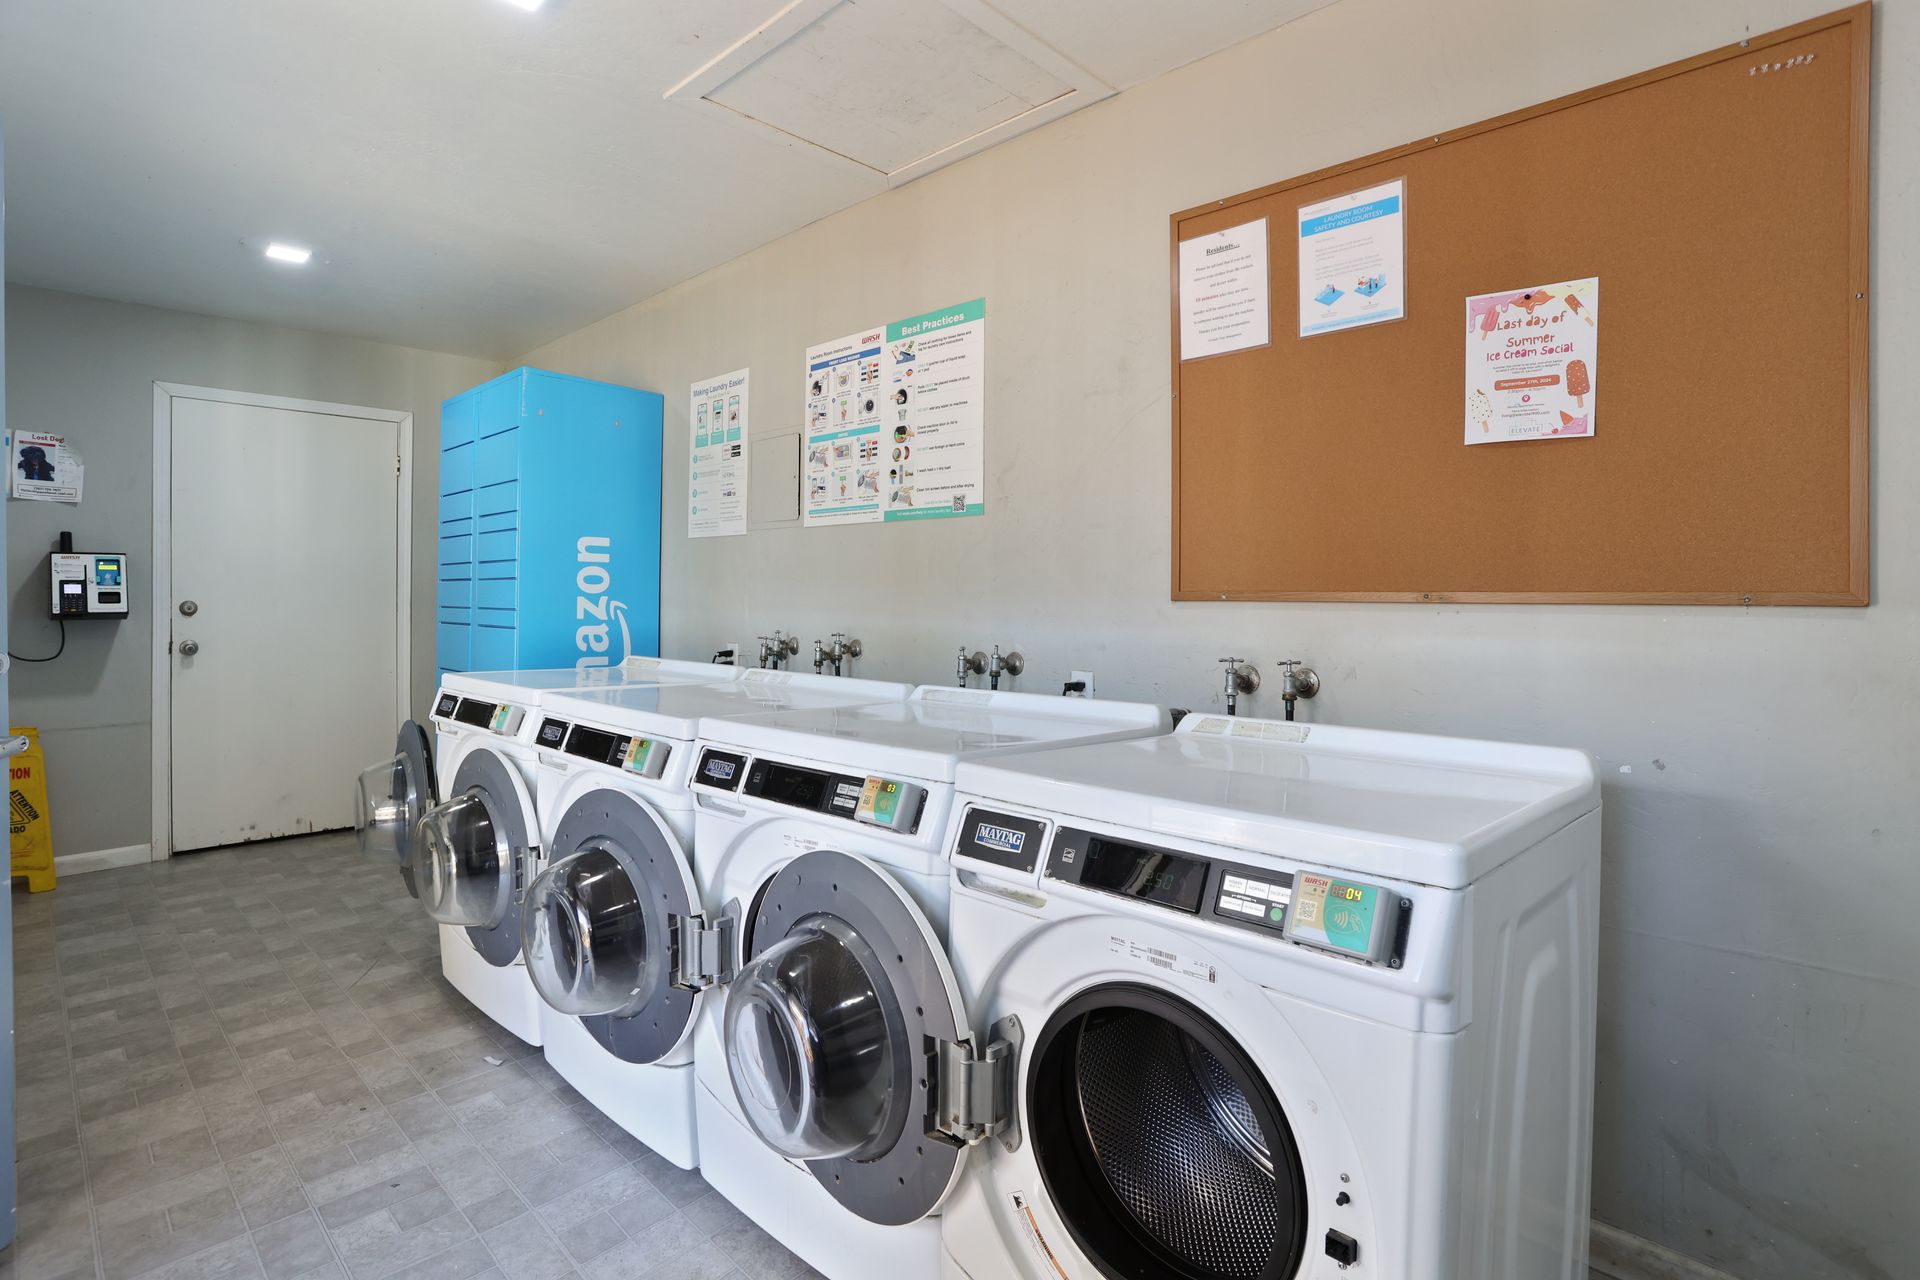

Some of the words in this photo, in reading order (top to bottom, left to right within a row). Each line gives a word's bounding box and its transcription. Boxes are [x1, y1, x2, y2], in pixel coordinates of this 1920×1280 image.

[1313, 221, 1335, 233] SAFETY
[1336, 218, 1351, 229] AND
[1351, 209, 1384, 225] COURTESY
[1323, 210, 1350, 223] LAUNDRY
[1350, 205, 1373, 216] ROOM
[901, 323, 920, 336] Best
[922, 313, 965, 330] Practices
[1496, 318, 1522, 331] Last
[1525, 314, 1549, 329] day
[1551, 310, 1568, 324] of
[1506, 333, 1556, 348] Summer
[1486, 350, 1501, 362] Ice
[1503, 348, 1537, 360] Cream
[1540, 342, 1574, 356] Social
[692, 387, 709, 398] Making
[709, 382, 729, 394] Laundry
[728, 377, 745, 389] Easier!
[1510, 426, 1541, 435] ELEVATE
[708, 758, 735, 773] MAYTAG
[887, 784, 897, 794] 03
[10, 789, 41, 822] ATTENTION
[979, 825, 1022, 846] MAYTAG
[983, 837, 1012, 849] COMMERCIAL
[1304, 876, 1329, 888] WASH
[1346, 887, 1363, 901] 04
